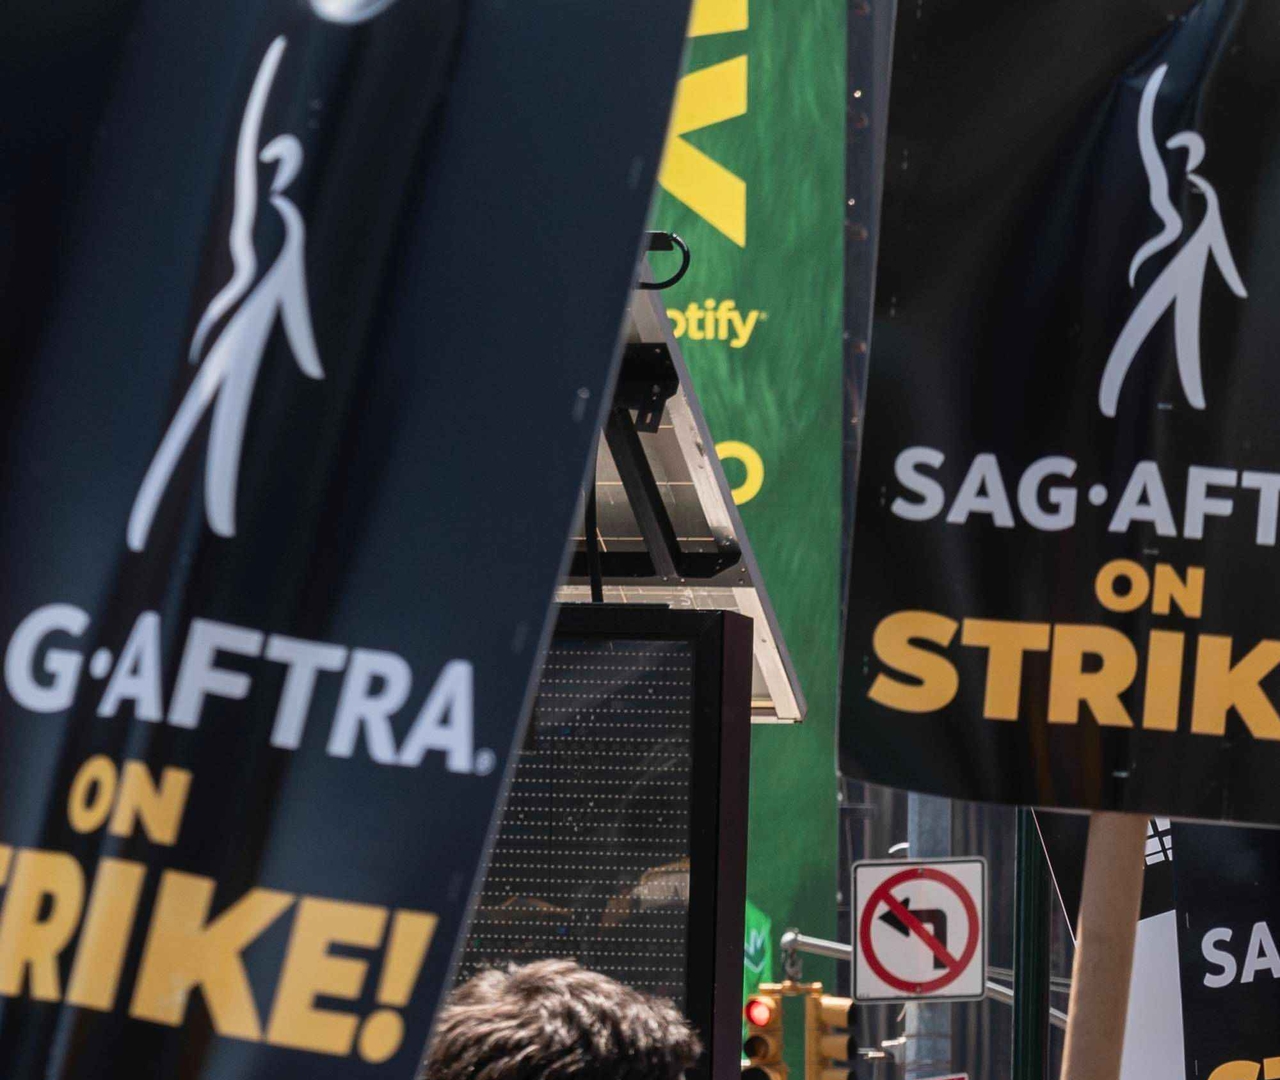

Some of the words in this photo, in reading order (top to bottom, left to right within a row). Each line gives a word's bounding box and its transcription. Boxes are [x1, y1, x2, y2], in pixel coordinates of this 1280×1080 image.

[1094, 558, 1205, 618] ON
[67, 754, 192, 847] ON
[0, 845, 439, 1064] RIKE!
